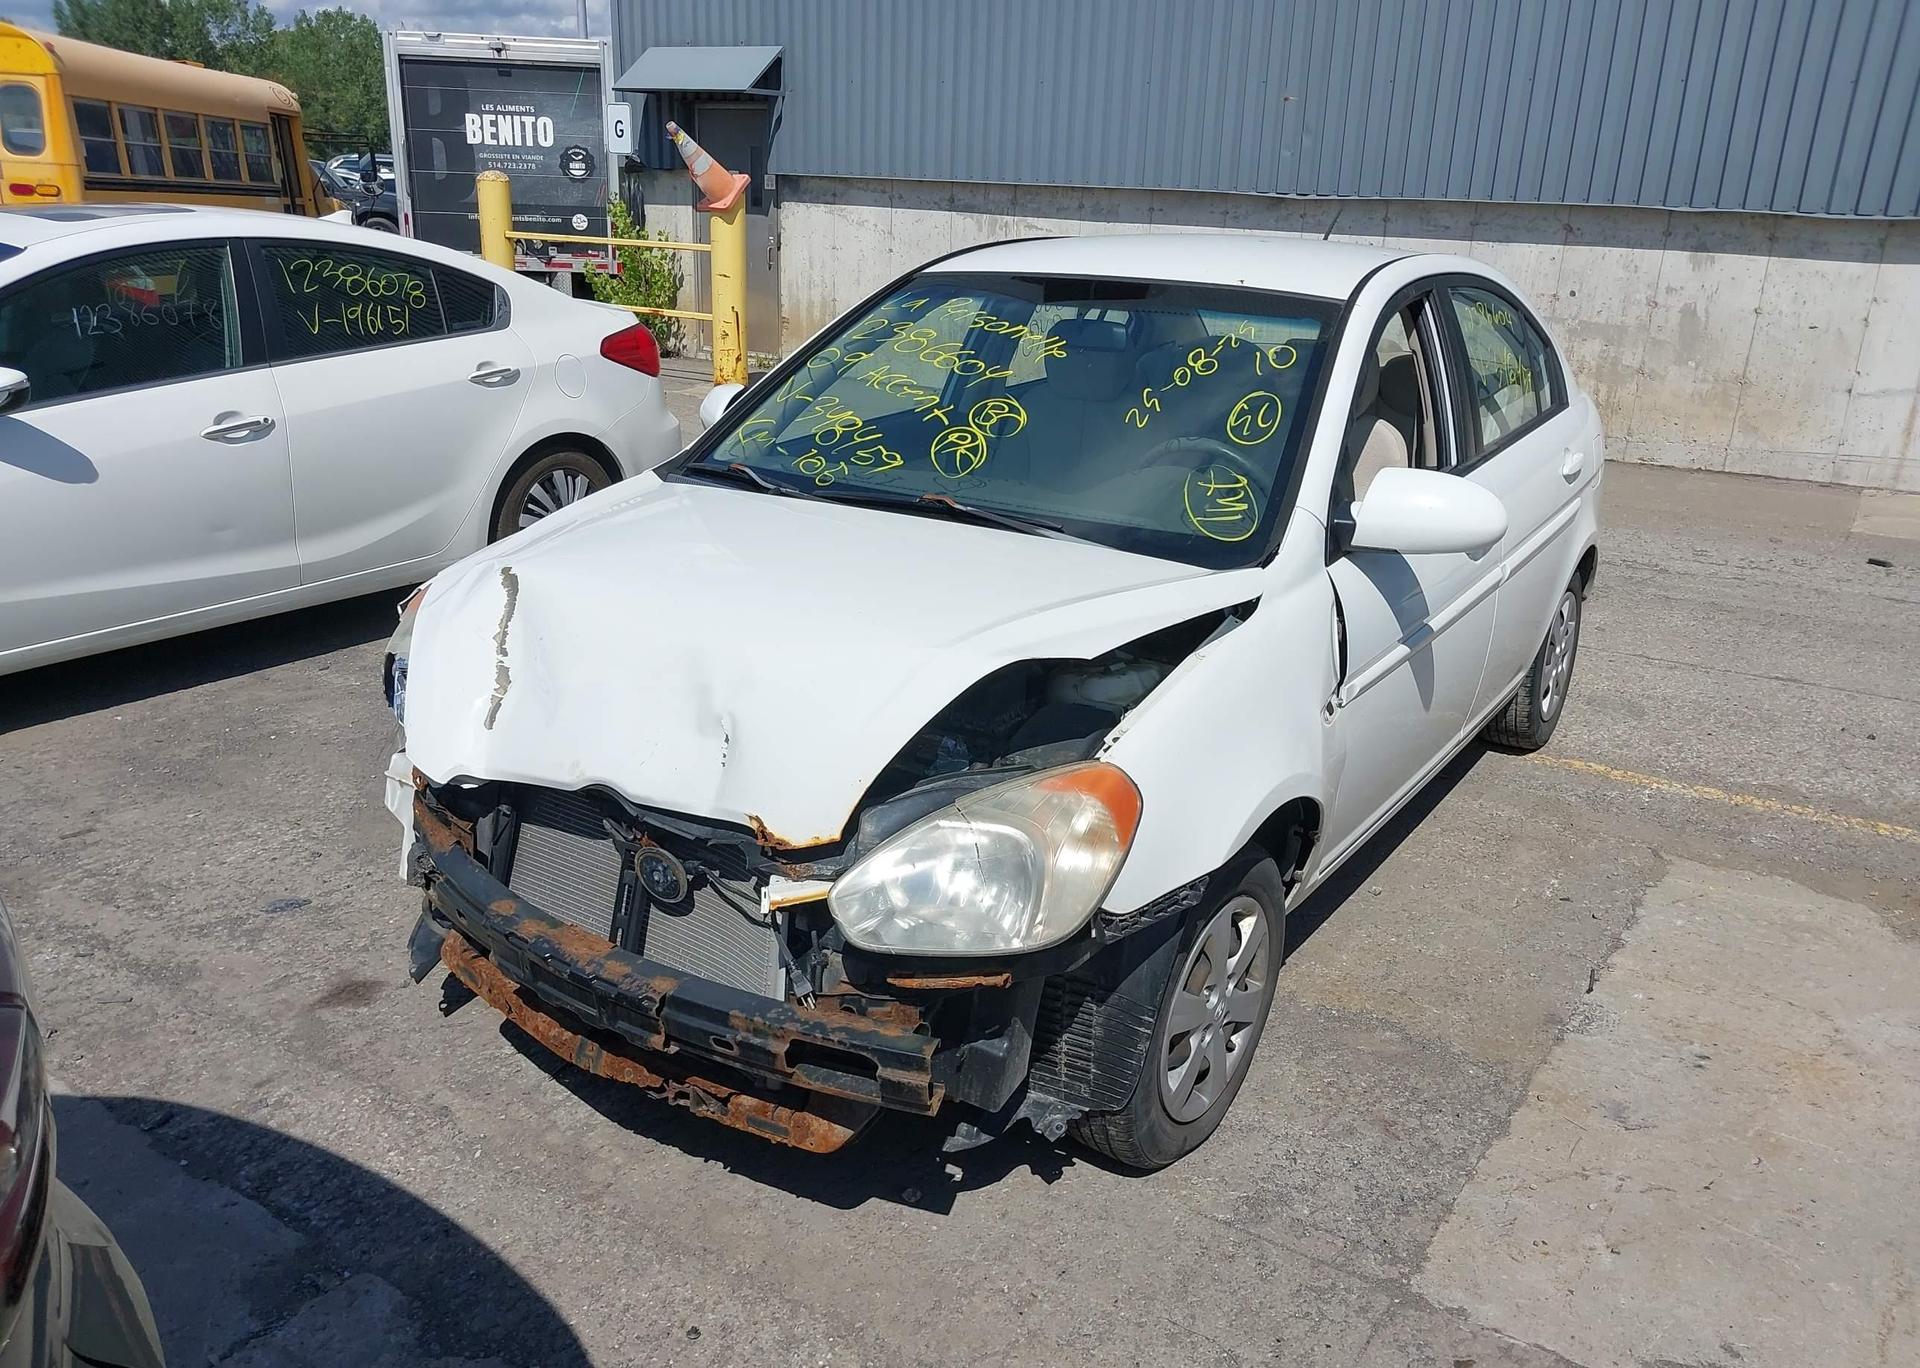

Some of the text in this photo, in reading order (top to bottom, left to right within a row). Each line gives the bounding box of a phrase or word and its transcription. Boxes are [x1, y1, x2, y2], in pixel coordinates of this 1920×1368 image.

[496, 104, 536, 113] ALIMENTS
[465, 113, 554, 147] BENITO
[614, 120, 625, 138] G
[479, 152, 511, 160] GROSSISTE
[278, 258, 426, 308] 12386078
[807, 348, 874, 375] 09
